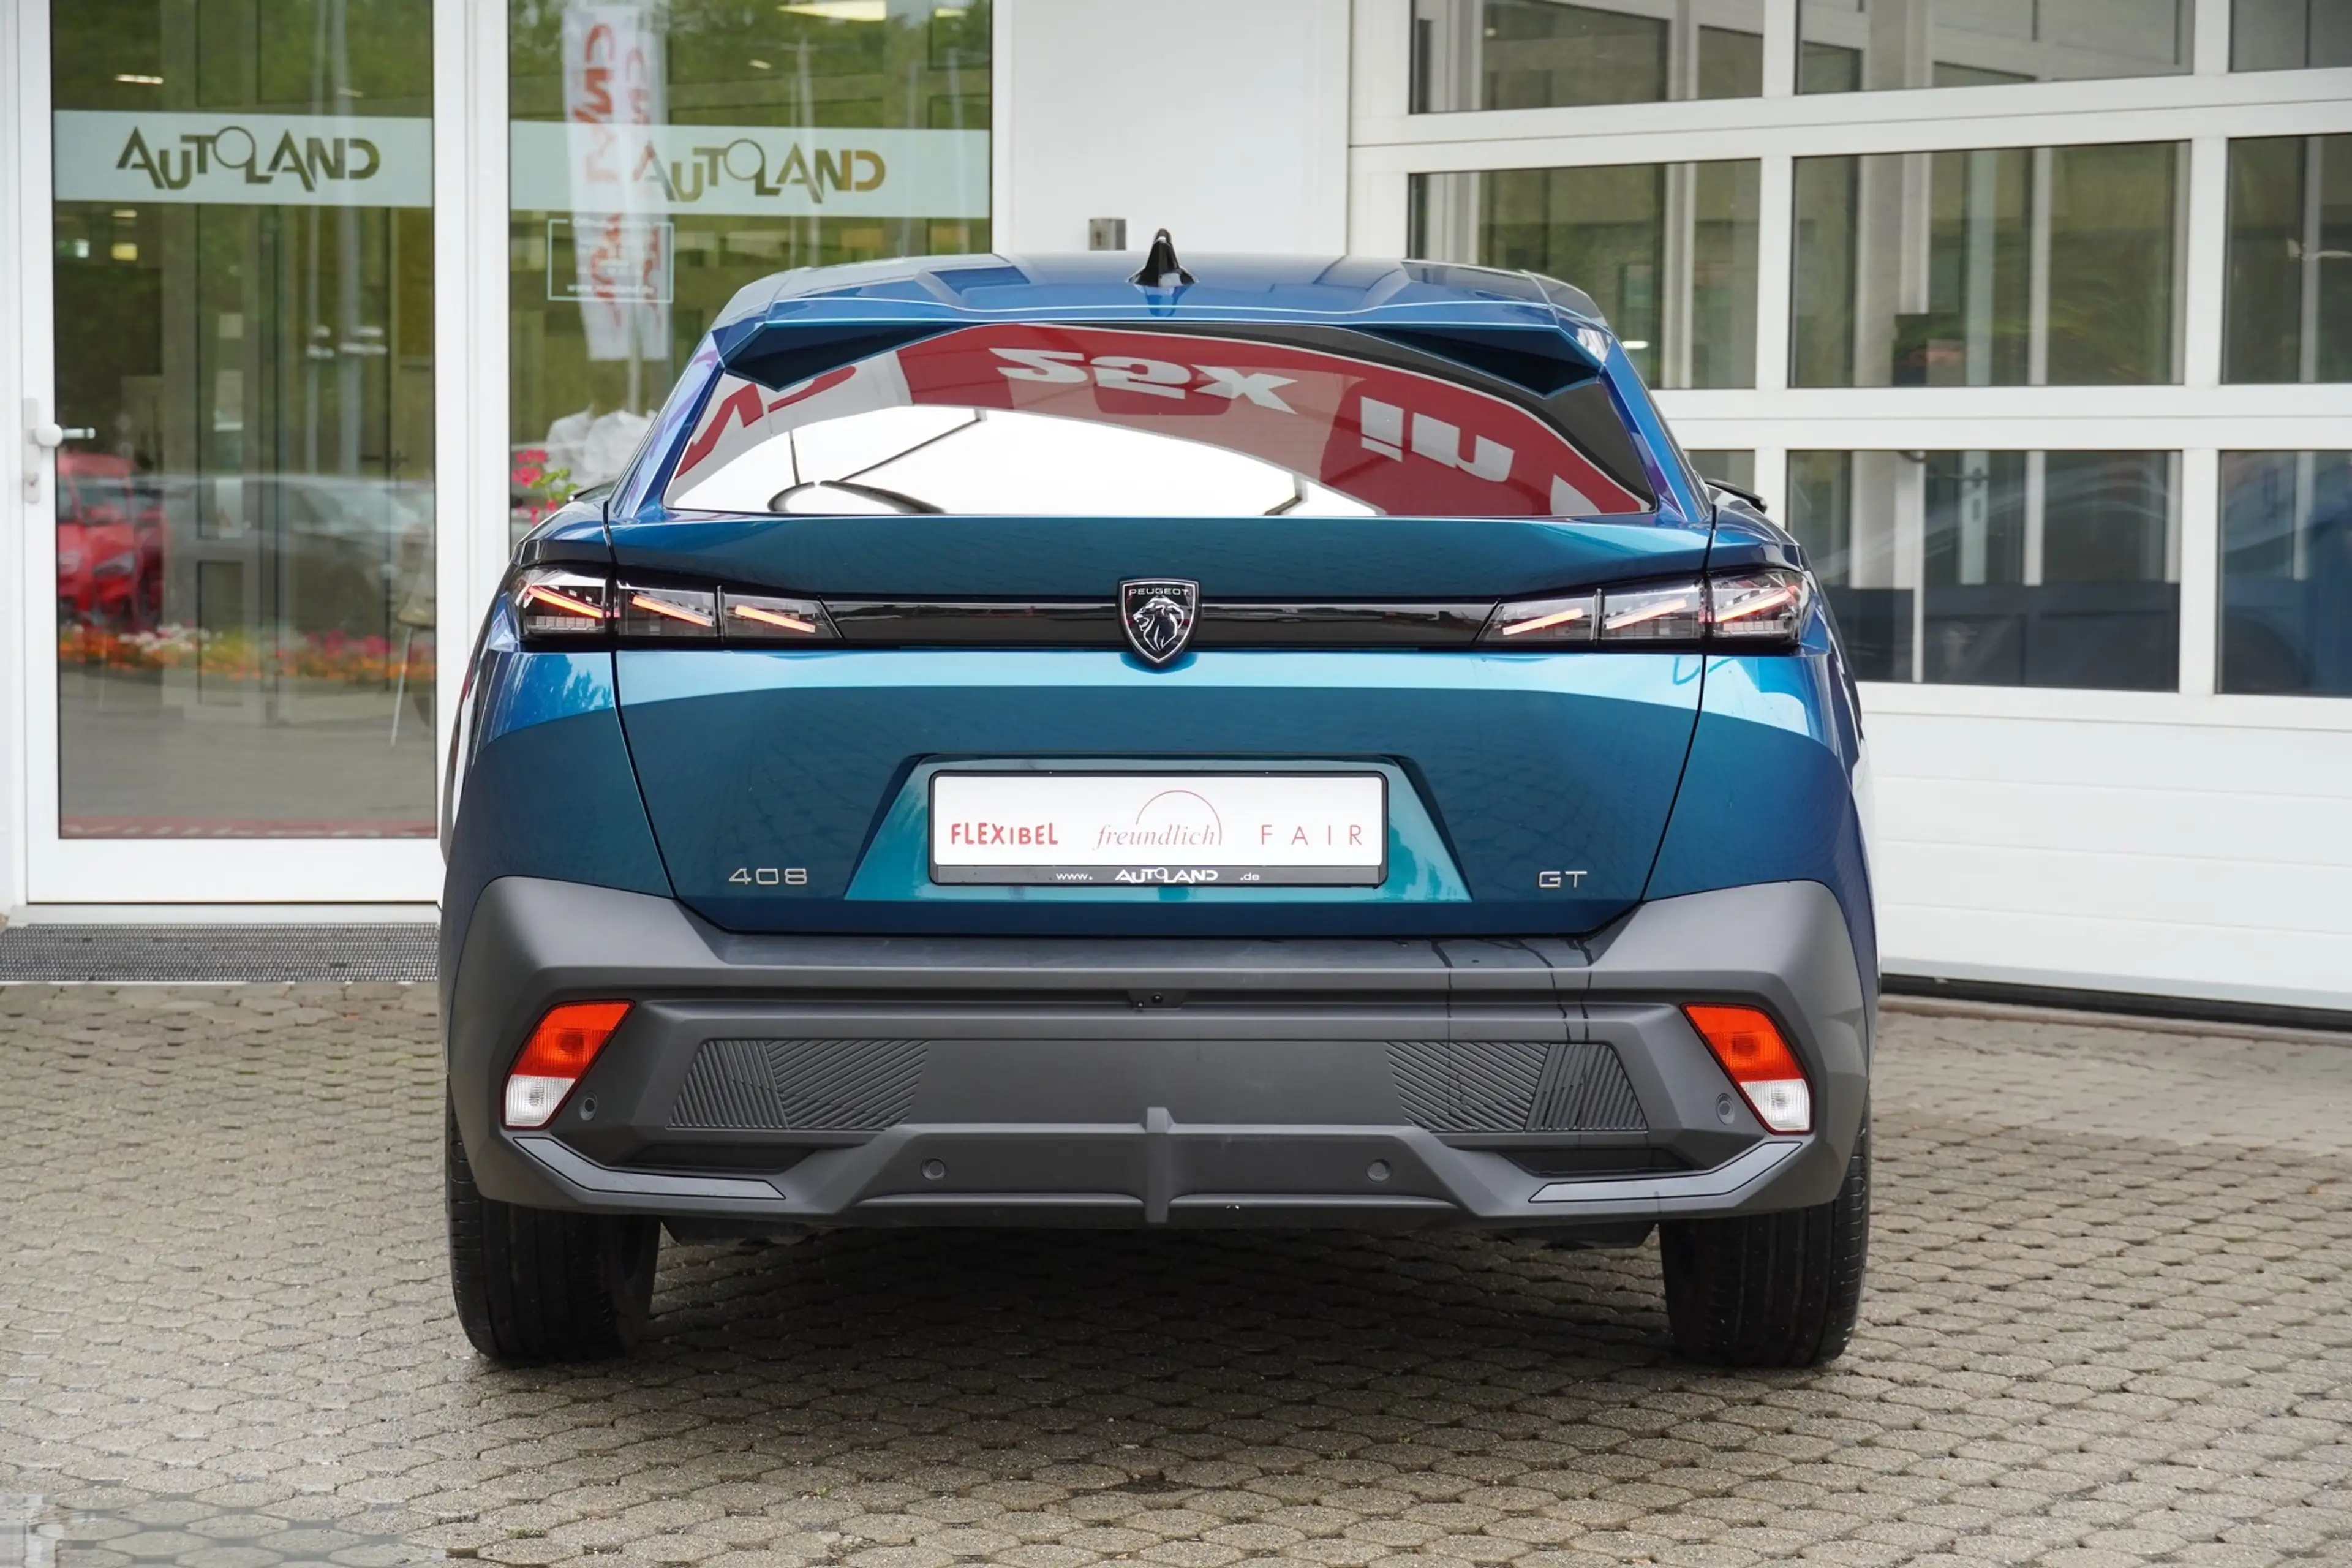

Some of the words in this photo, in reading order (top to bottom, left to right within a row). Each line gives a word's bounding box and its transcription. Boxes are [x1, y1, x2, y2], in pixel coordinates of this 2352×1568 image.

[116, 126, 380, 192] AUTOLAND
[633, 138, 886, 204] AUTOLAND
[951, 823, 1058, 845] FLEXIBEL
[1092, 824, 1215, 851] freundlich
[1261, 824, 1362, 846] FAIR
[729, 868, 807, 884] 408
[1115, 867, 1218, 883] AUTOLAND
[1539, 870, 1588, 888] GT
